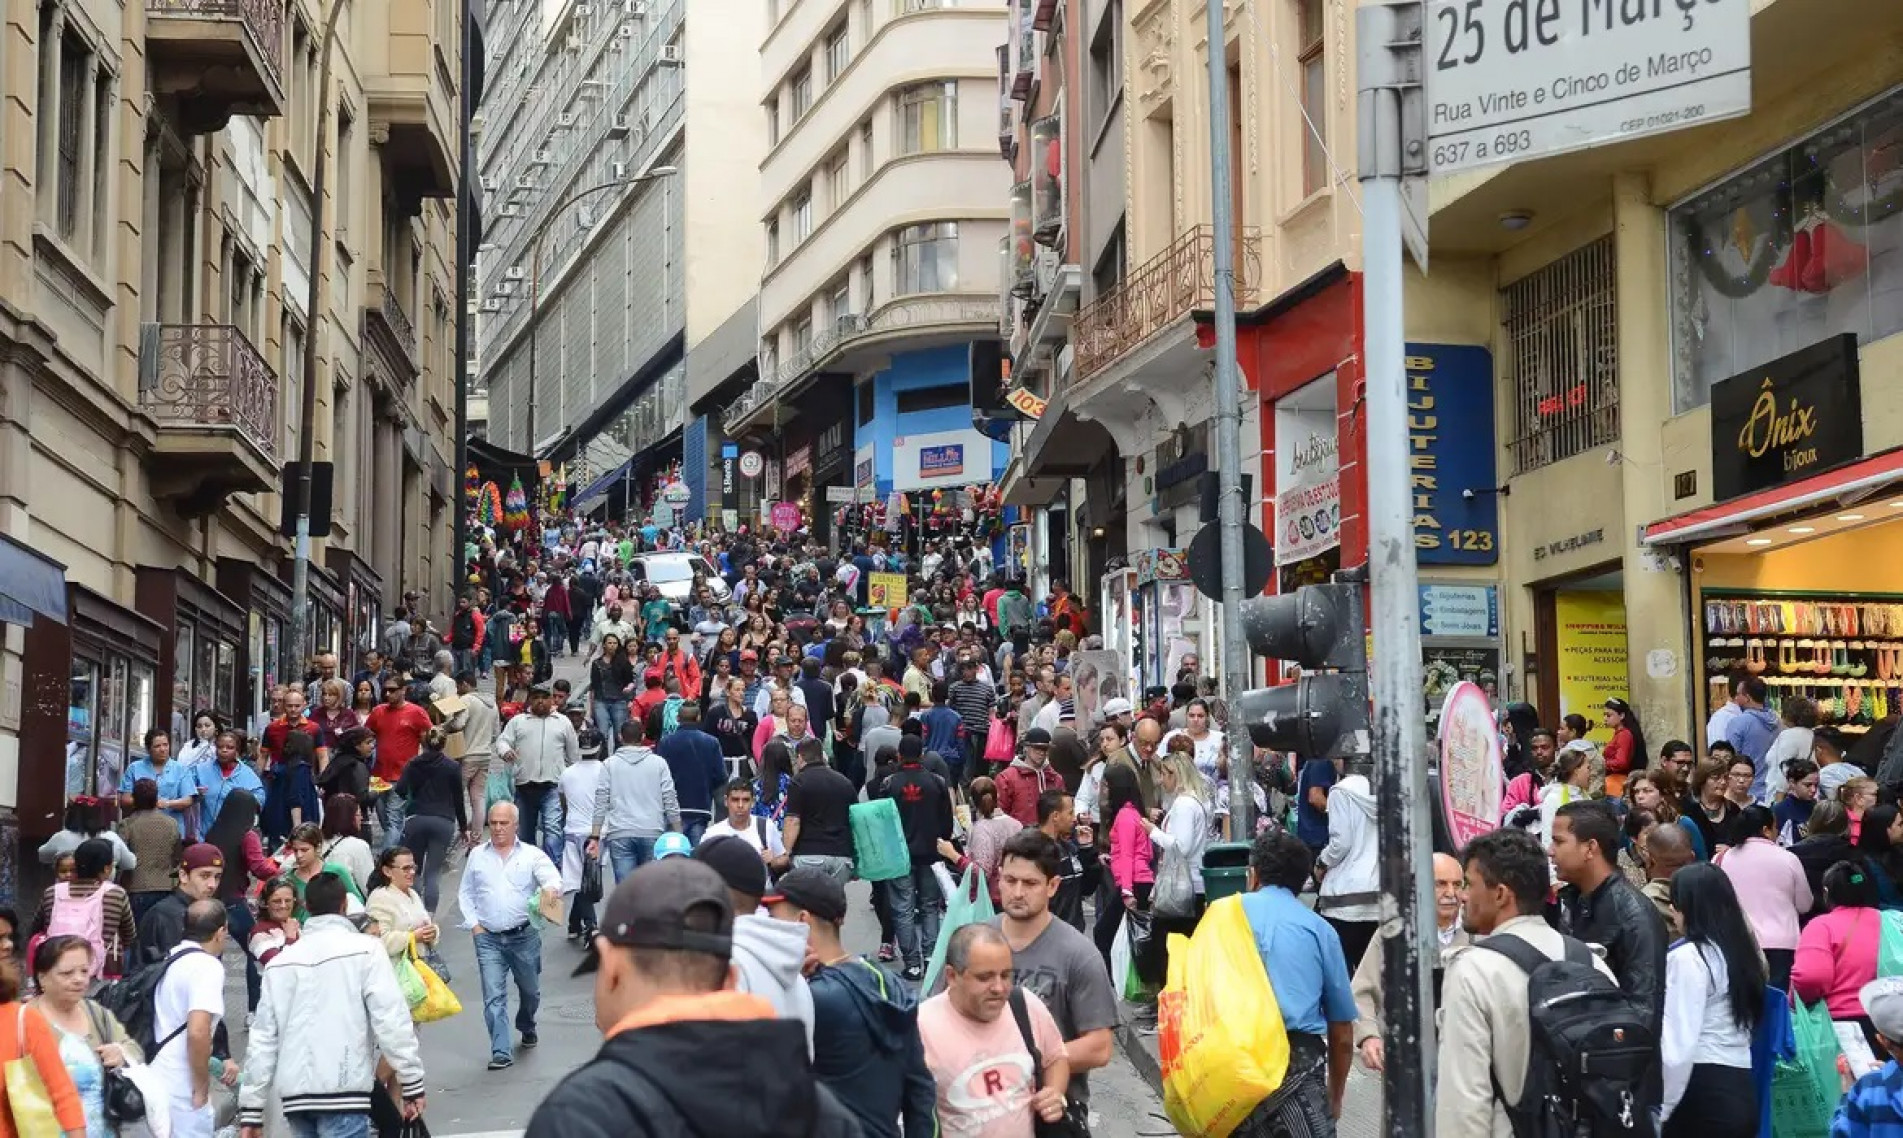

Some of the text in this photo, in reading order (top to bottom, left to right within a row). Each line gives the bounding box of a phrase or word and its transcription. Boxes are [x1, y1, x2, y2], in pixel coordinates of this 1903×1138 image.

[1437, 0, 1722, 71] 25 de Maç
[1434, 47, 1712, 124] Rua Vinte e Cinco de Março
[1620, 104, 1705, 132] CEP 01021-200
[1434, 130, 1531, 165] 637 a 693
[1014, 390, 1047, 416] 103
[1739, 376, 1818, 458] Ônix
[1405, 356, 1441, 549] BIJUTERIAS
[1783, 449, 1818, 471] bijoux
[1449, 529, 1493, 551] 123
[983, 1069, 1003, 1096] R
